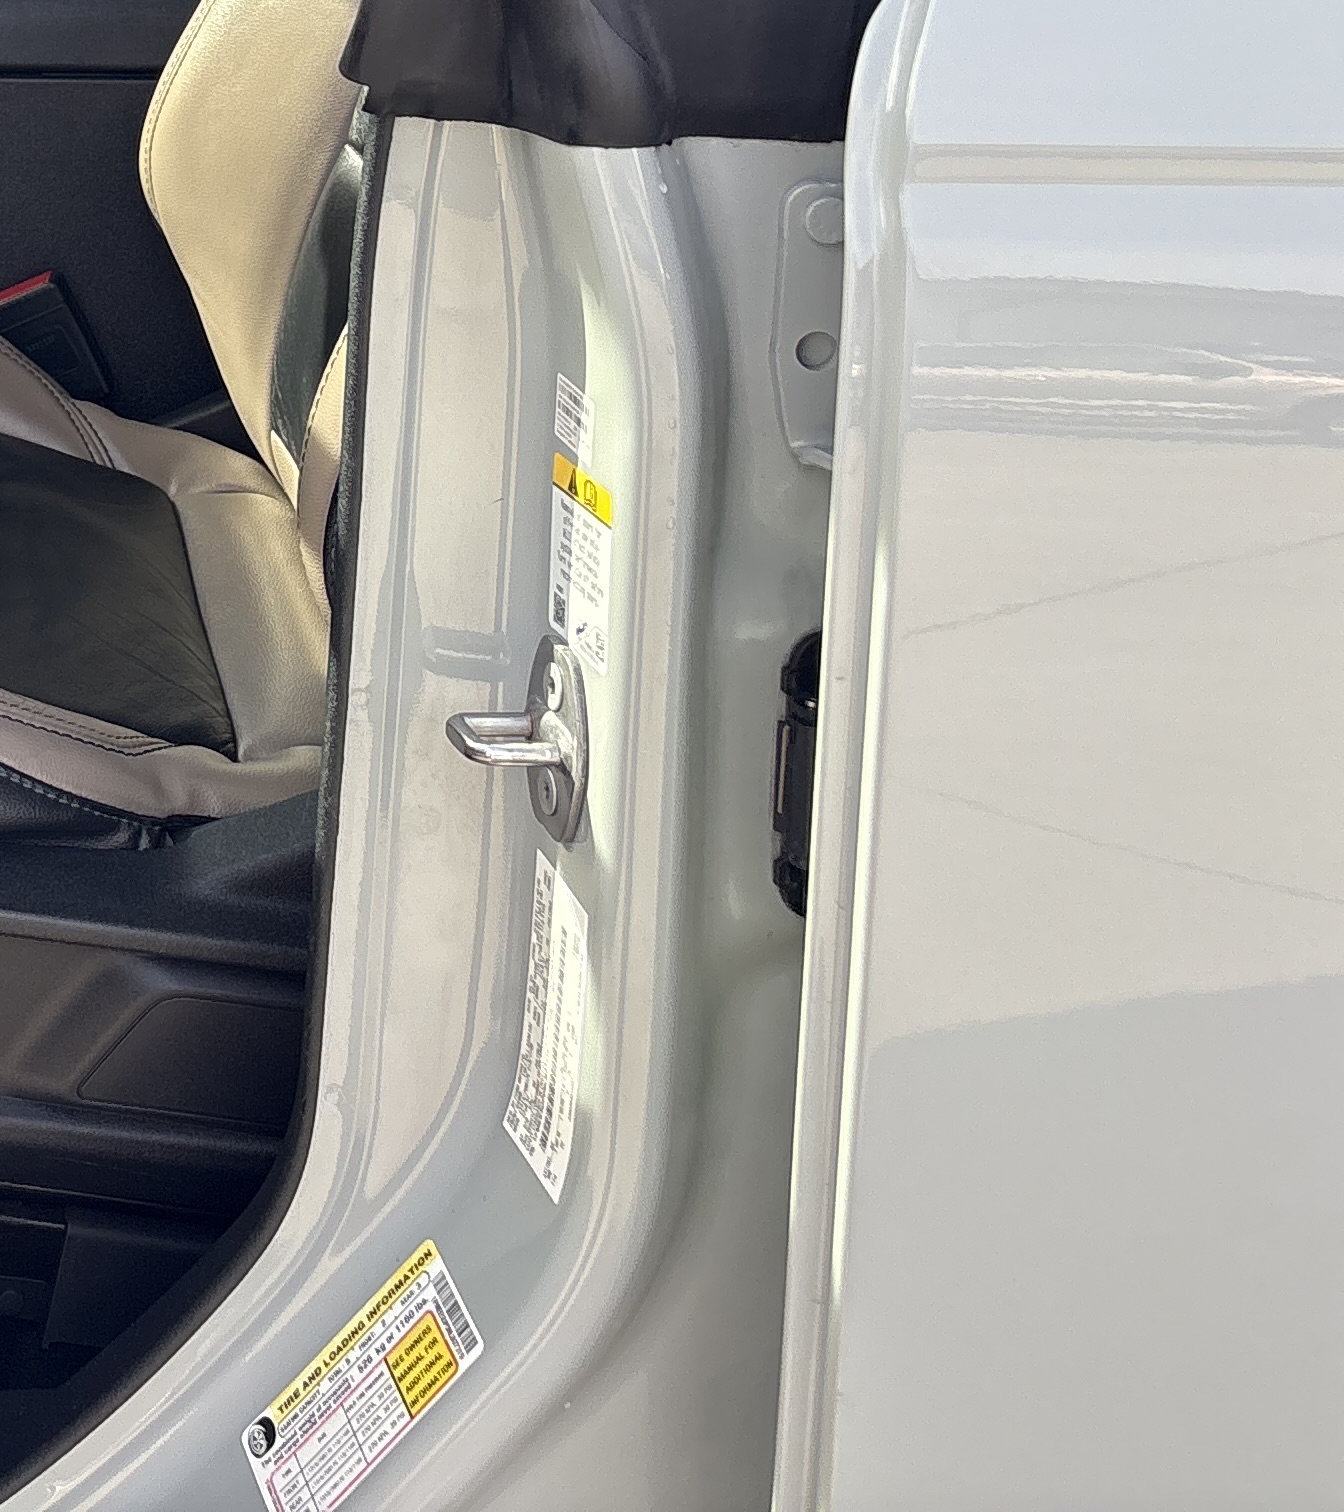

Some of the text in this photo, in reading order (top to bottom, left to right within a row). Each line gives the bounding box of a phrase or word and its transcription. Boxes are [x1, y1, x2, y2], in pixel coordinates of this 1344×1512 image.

[276, 1246, 433, 1416] TIRE AND LOADING INFORMATION
[390, 1351, 405, 1371] SEE
[396, 1334, 439, 1384] MANUAL FOR
[403, 1349, 444, 1395] ADDITIONAL
[407, 1357, 454, 1411] INFORMATION
